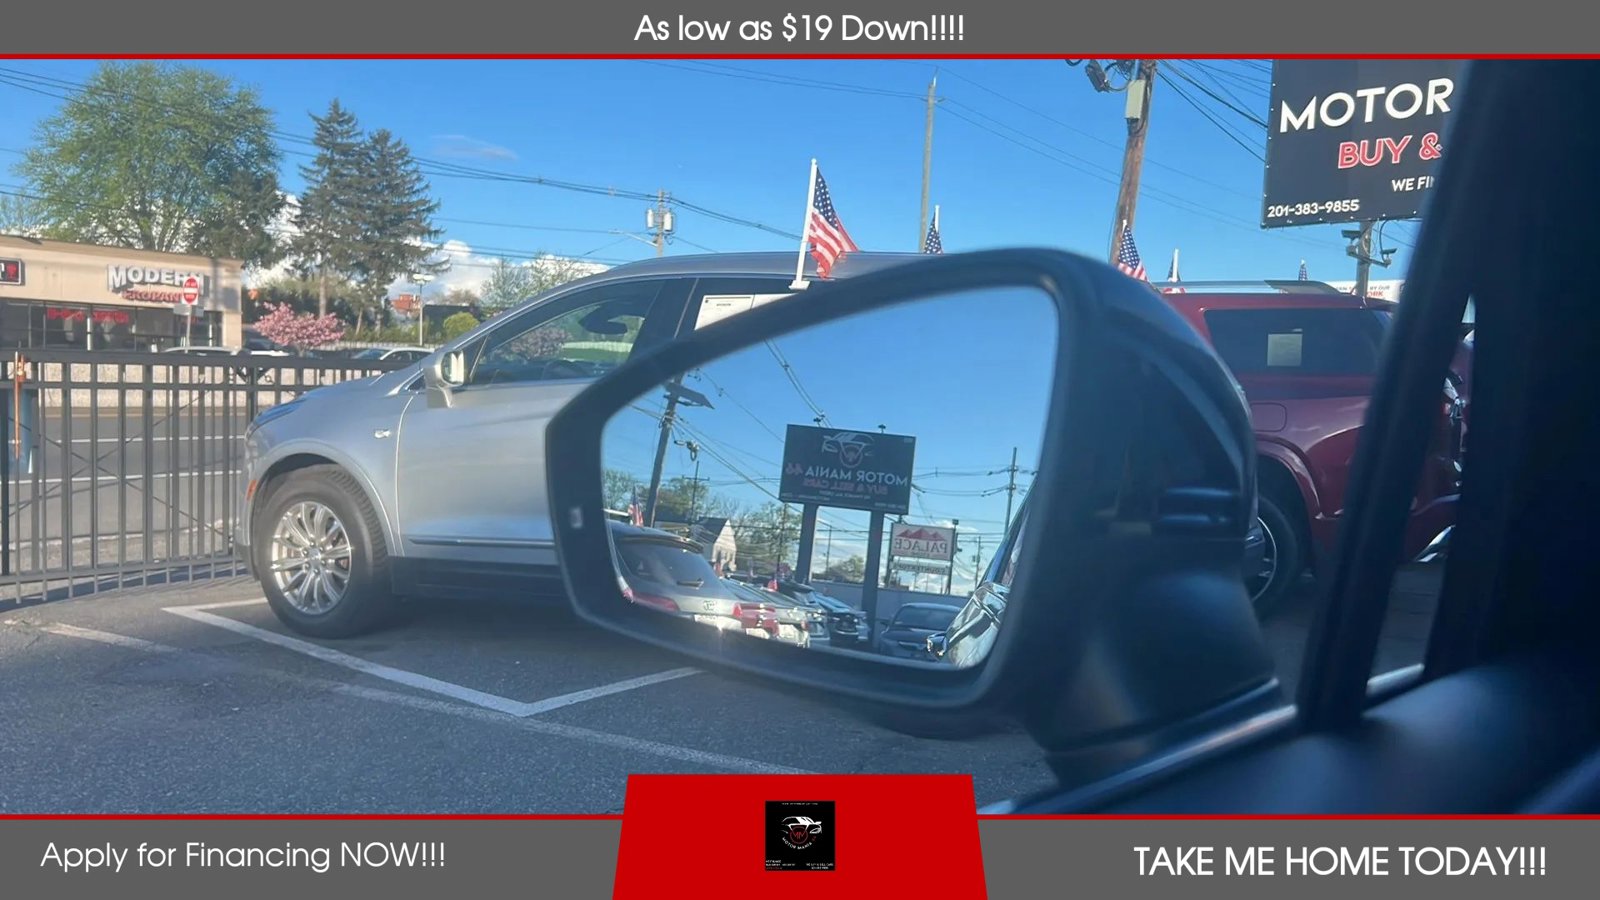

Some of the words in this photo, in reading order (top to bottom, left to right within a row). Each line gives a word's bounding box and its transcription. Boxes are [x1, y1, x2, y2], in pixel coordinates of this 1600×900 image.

[1279, 77, 1455, 133] MOTOR
[1337, 135, 1413, 169] BUY
[1419, 132, 1443, 160] &
[1391, 177, 1415, 192] WE
[1267, 199, 1361, 218] 201-383-9855
